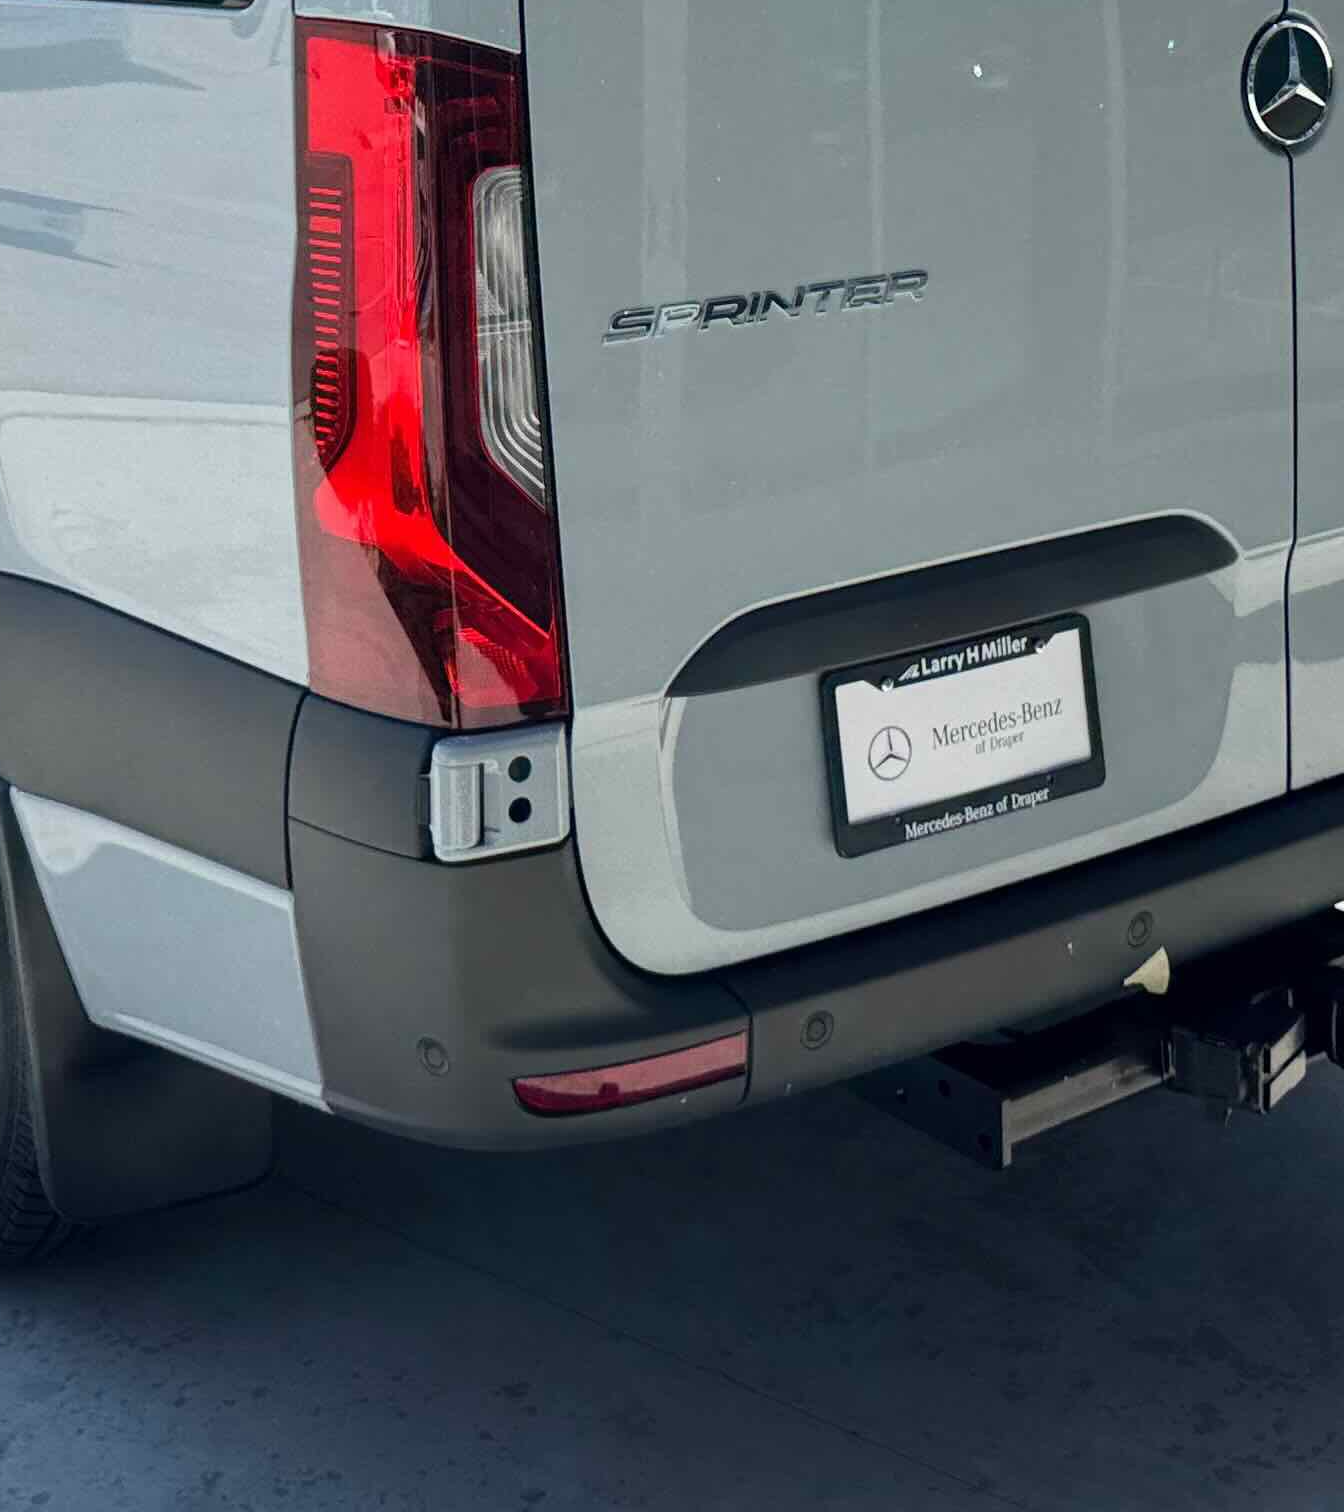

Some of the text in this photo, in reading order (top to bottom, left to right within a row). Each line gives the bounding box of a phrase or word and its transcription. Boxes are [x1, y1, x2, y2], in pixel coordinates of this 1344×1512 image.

[601, 269, 929, 346] SPRINTER
[921, 635, 1028, 676] Larry H Miller
[931, 696, 1064, 751] Mercedes-Benz
[974, 730, 1026, 755] of Draper
[904, 787, 1050, 840] Mercedes-Benz of Draper
